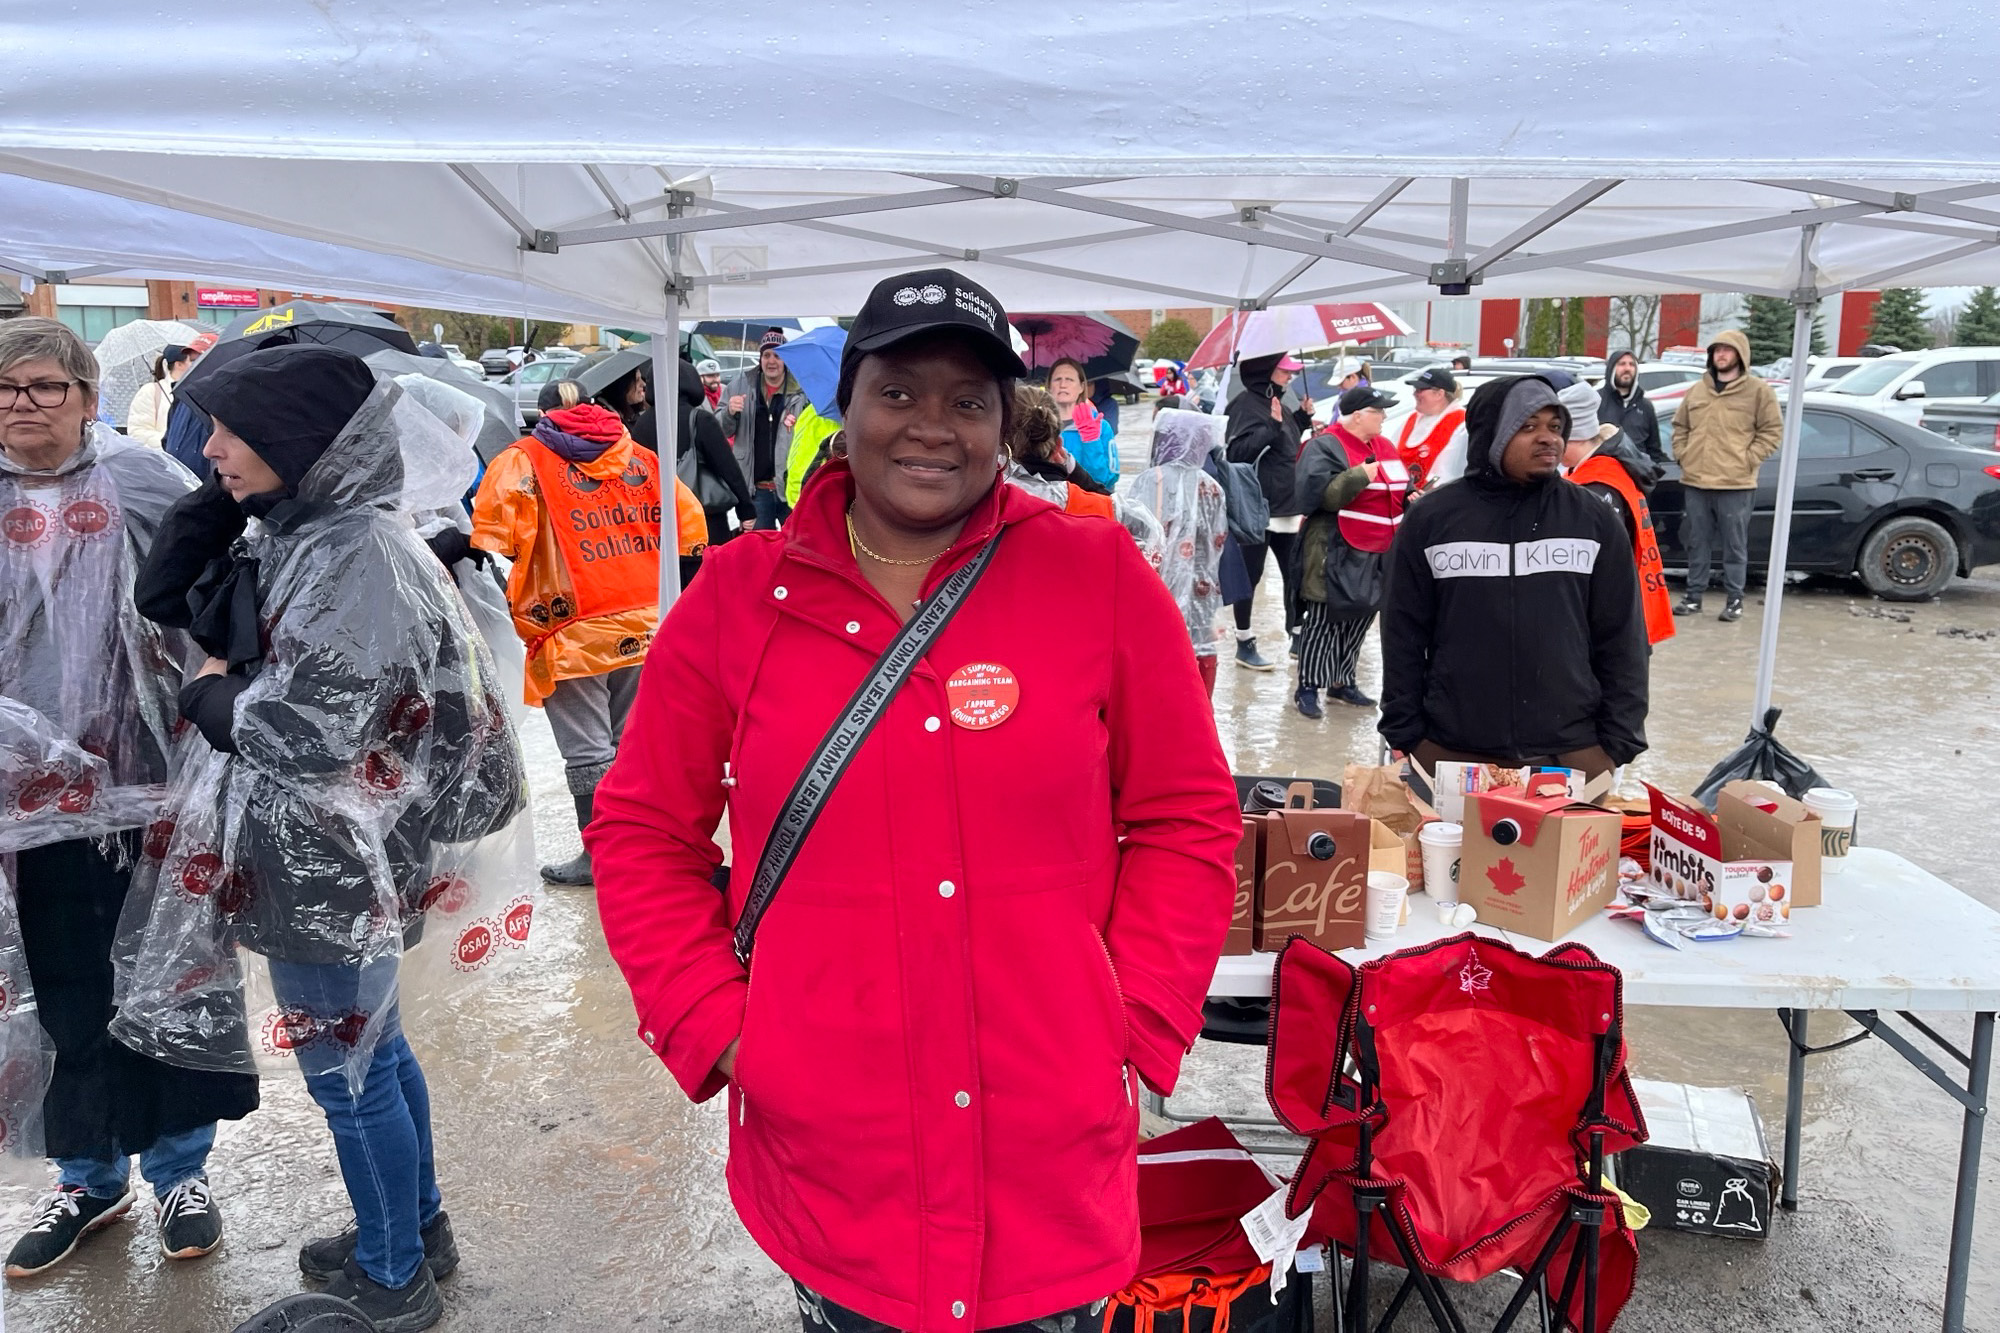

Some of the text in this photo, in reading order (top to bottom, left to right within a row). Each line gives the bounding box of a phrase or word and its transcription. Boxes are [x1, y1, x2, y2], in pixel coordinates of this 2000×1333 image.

[201, 292, 233, 303] amplifon
[955, 287, 997, 320] Solidarity
[244, 320, 293, 336] NAUTICA
[5, 511, 107, 532] PSAC AFPC
[1433, 543, 1590, 573] Calvin Klein
[620, 641, 640, 655] PSAC
[967, 664, 1002, 674] SUPPORT
[949, 677, 1012, 687] BARGAINING TEAM
[963, 700, 997, 709] J'APPUIE
[979, 716, 990, 725] DE
[752, 561, 978, 910] TOMMY JEANS TOMMY JEANS TOMMY JEANS TOMMY JEANS
[1661, 808, 1707, 841] BOÎTE DE 50
[1578, 826, 1600, 863] Tim
[1567, 847, 1611, 902] Hortons
[1654, 834, 1716, 893] timbits
[1257, 857, 1365, 936] Café
[1568, 892, 1586, 916] share
[461, 932, 489, 958] PSAC
